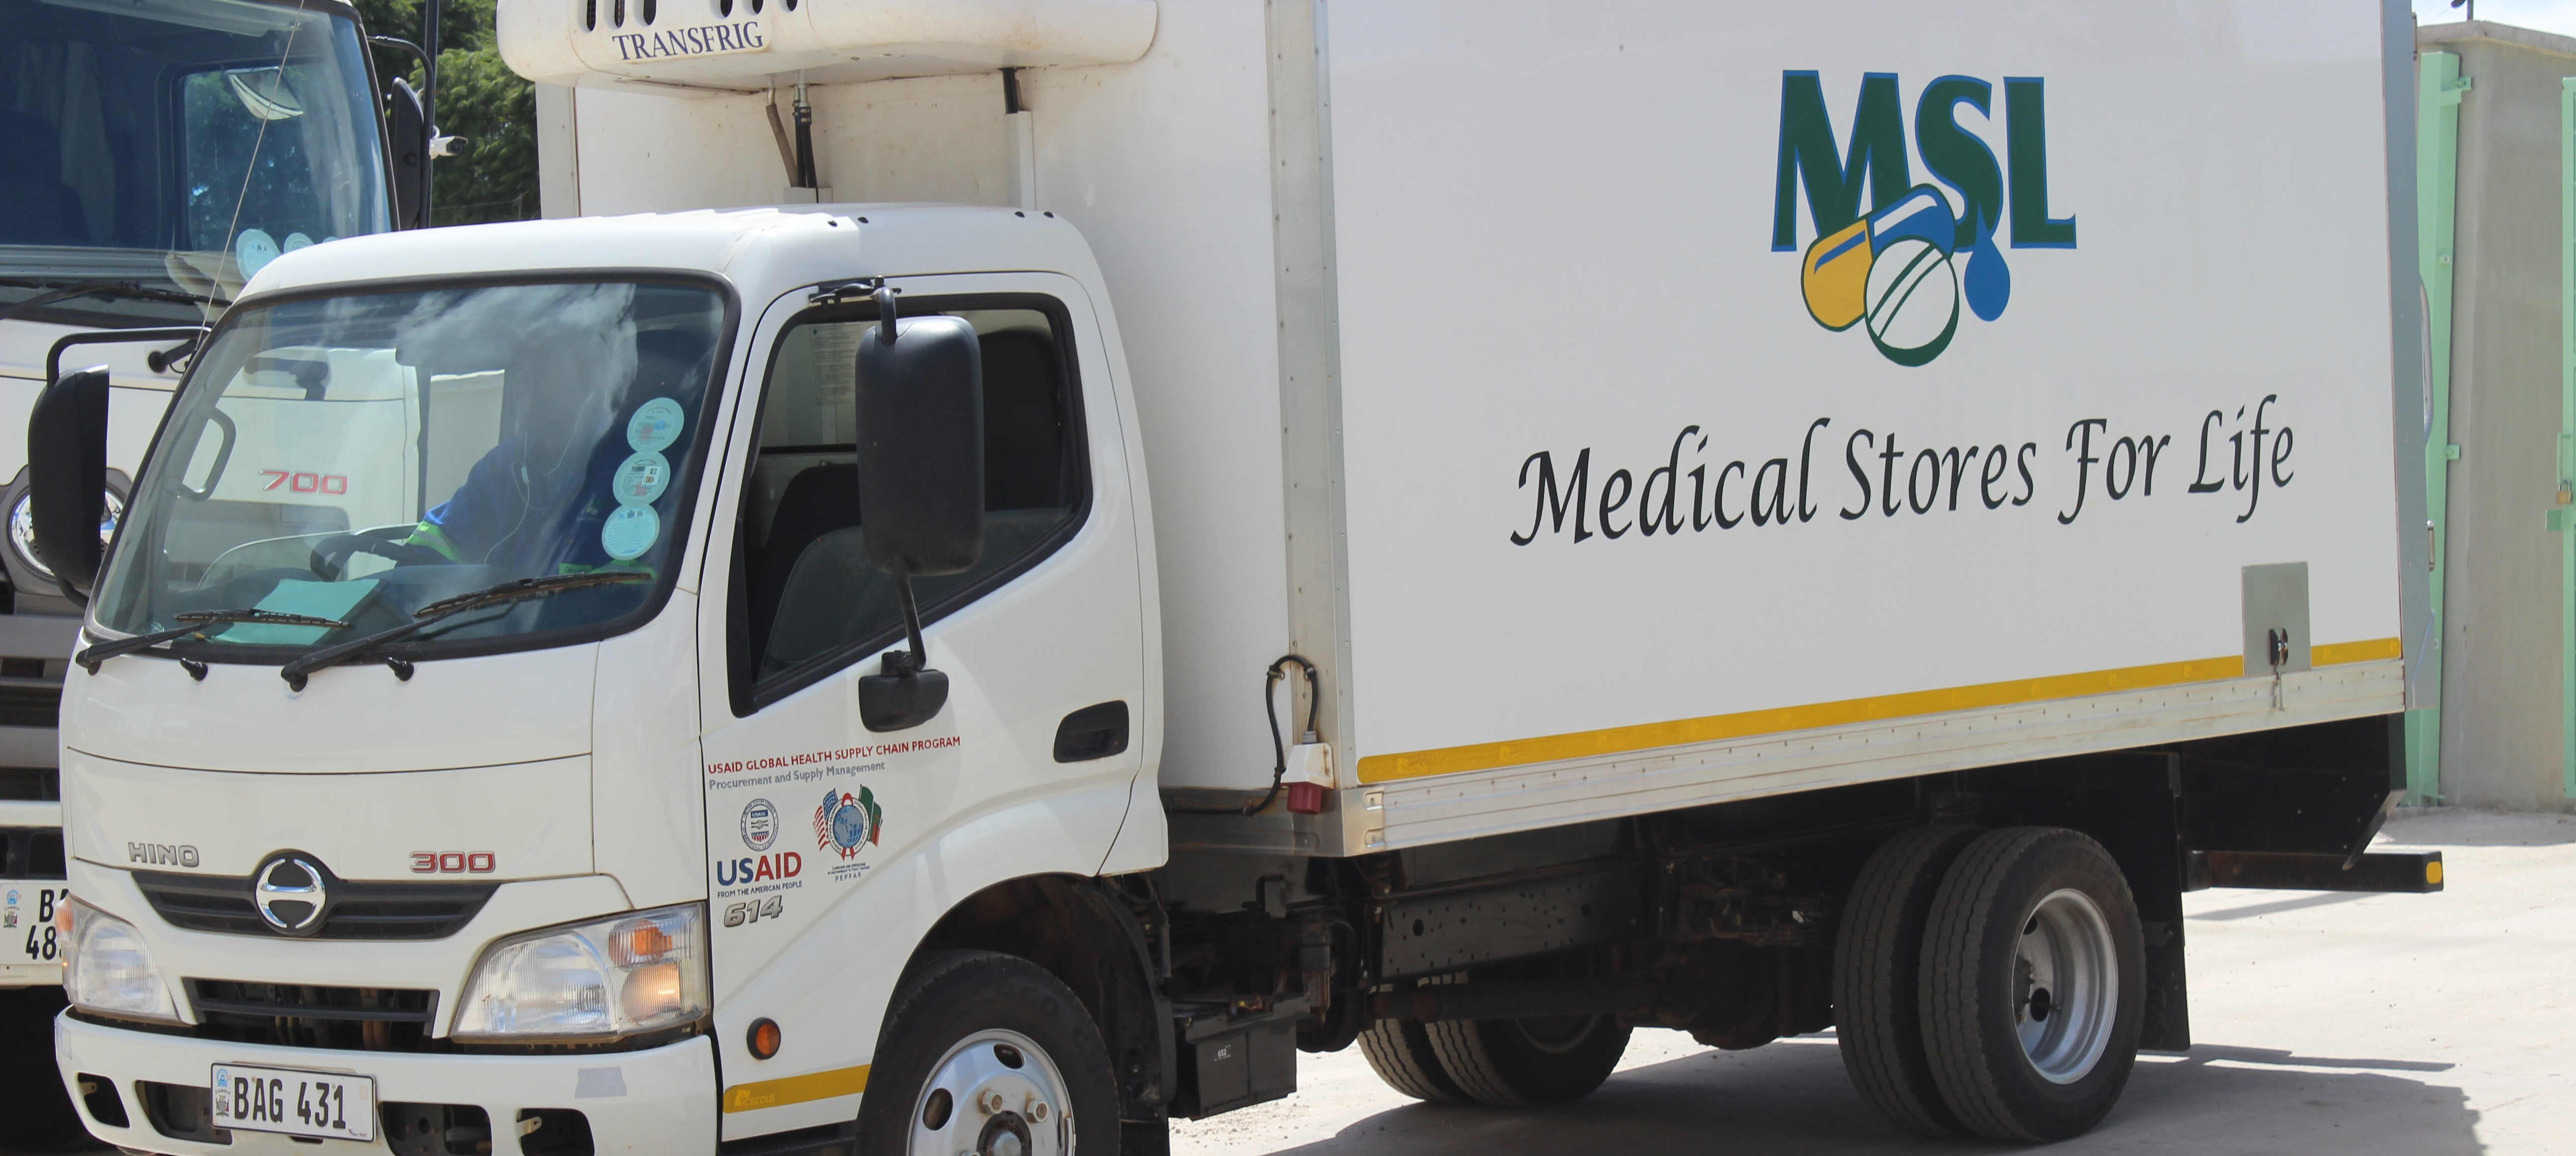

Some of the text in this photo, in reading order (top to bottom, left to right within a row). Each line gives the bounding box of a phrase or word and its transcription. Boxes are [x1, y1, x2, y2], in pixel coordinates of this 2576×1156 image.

[612, 21, 763, 61] TRANSFRIG
[1771, 70, 2077, 253] MSL
[259, 470, 347, 495] 700
[1510, 395, 2294, 546] Medical Stores For Life
[708, 736, 961, 774] USAID GLOBAL HEALTH SUPPLY CHAIN PROGRAM
[709, 761, 885, 790] Procurement and Supply Management
[128, 842, 199, 868] HINO
[410, 851, 496, 874] 300
[717, 851, 802, 886] USAID
[718, 890, 735, 899] FROM
[750, 884, 781, 894] AMERICAN
[782, 881, 802, 890] PEOPLE
[835, 872, 861, 882] PEPFAR
[39, 889, 69, 922] B
[724, 895, 783, 928] 614
[26, 925, 62, 960] 48
[234, 1077, 346, 1129] BAG 431
